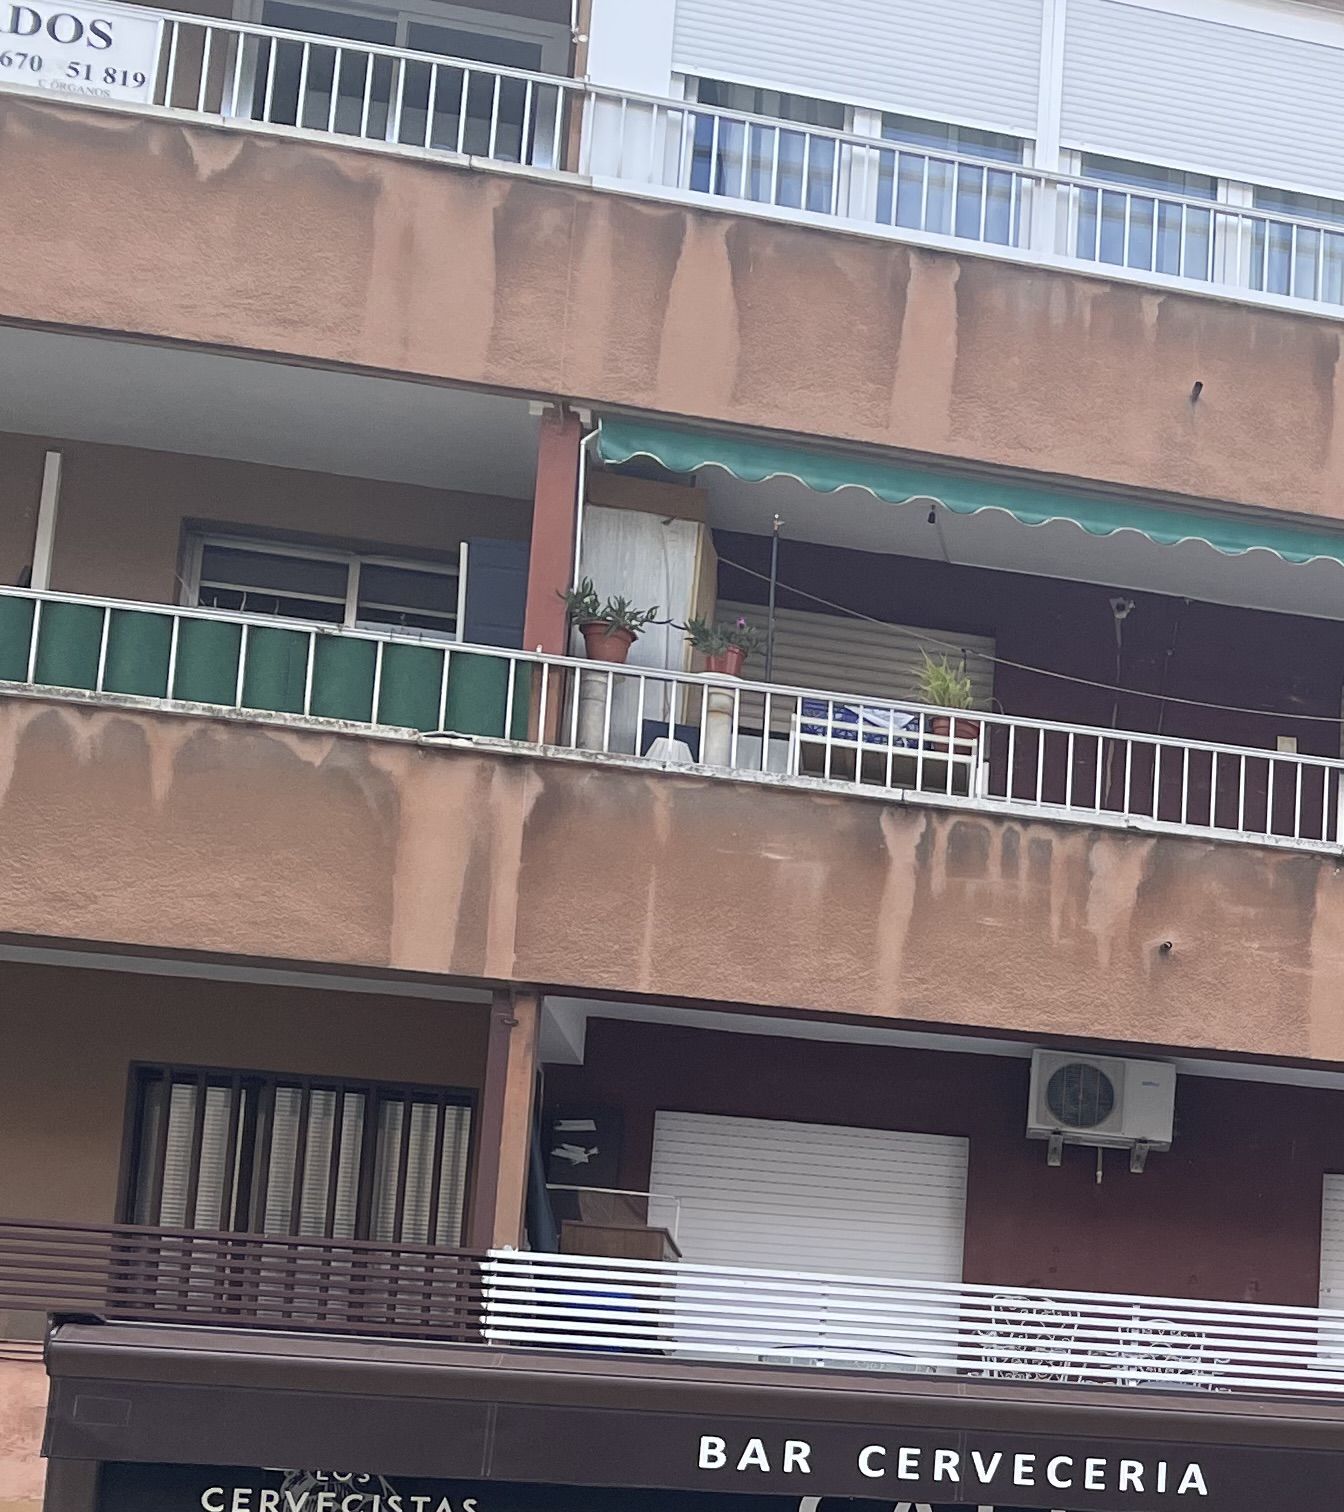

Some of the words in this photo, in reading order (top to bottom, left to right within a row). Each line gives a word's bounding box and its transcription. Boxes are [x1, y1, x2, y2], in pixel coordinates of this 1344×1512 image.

[0, 4, 113, 50] DOS
[103, 67, 146, 88] 819
[698, 1436, 812, 1473] BAR
[858, 1445, 1208, 1495] CERVECERIA
